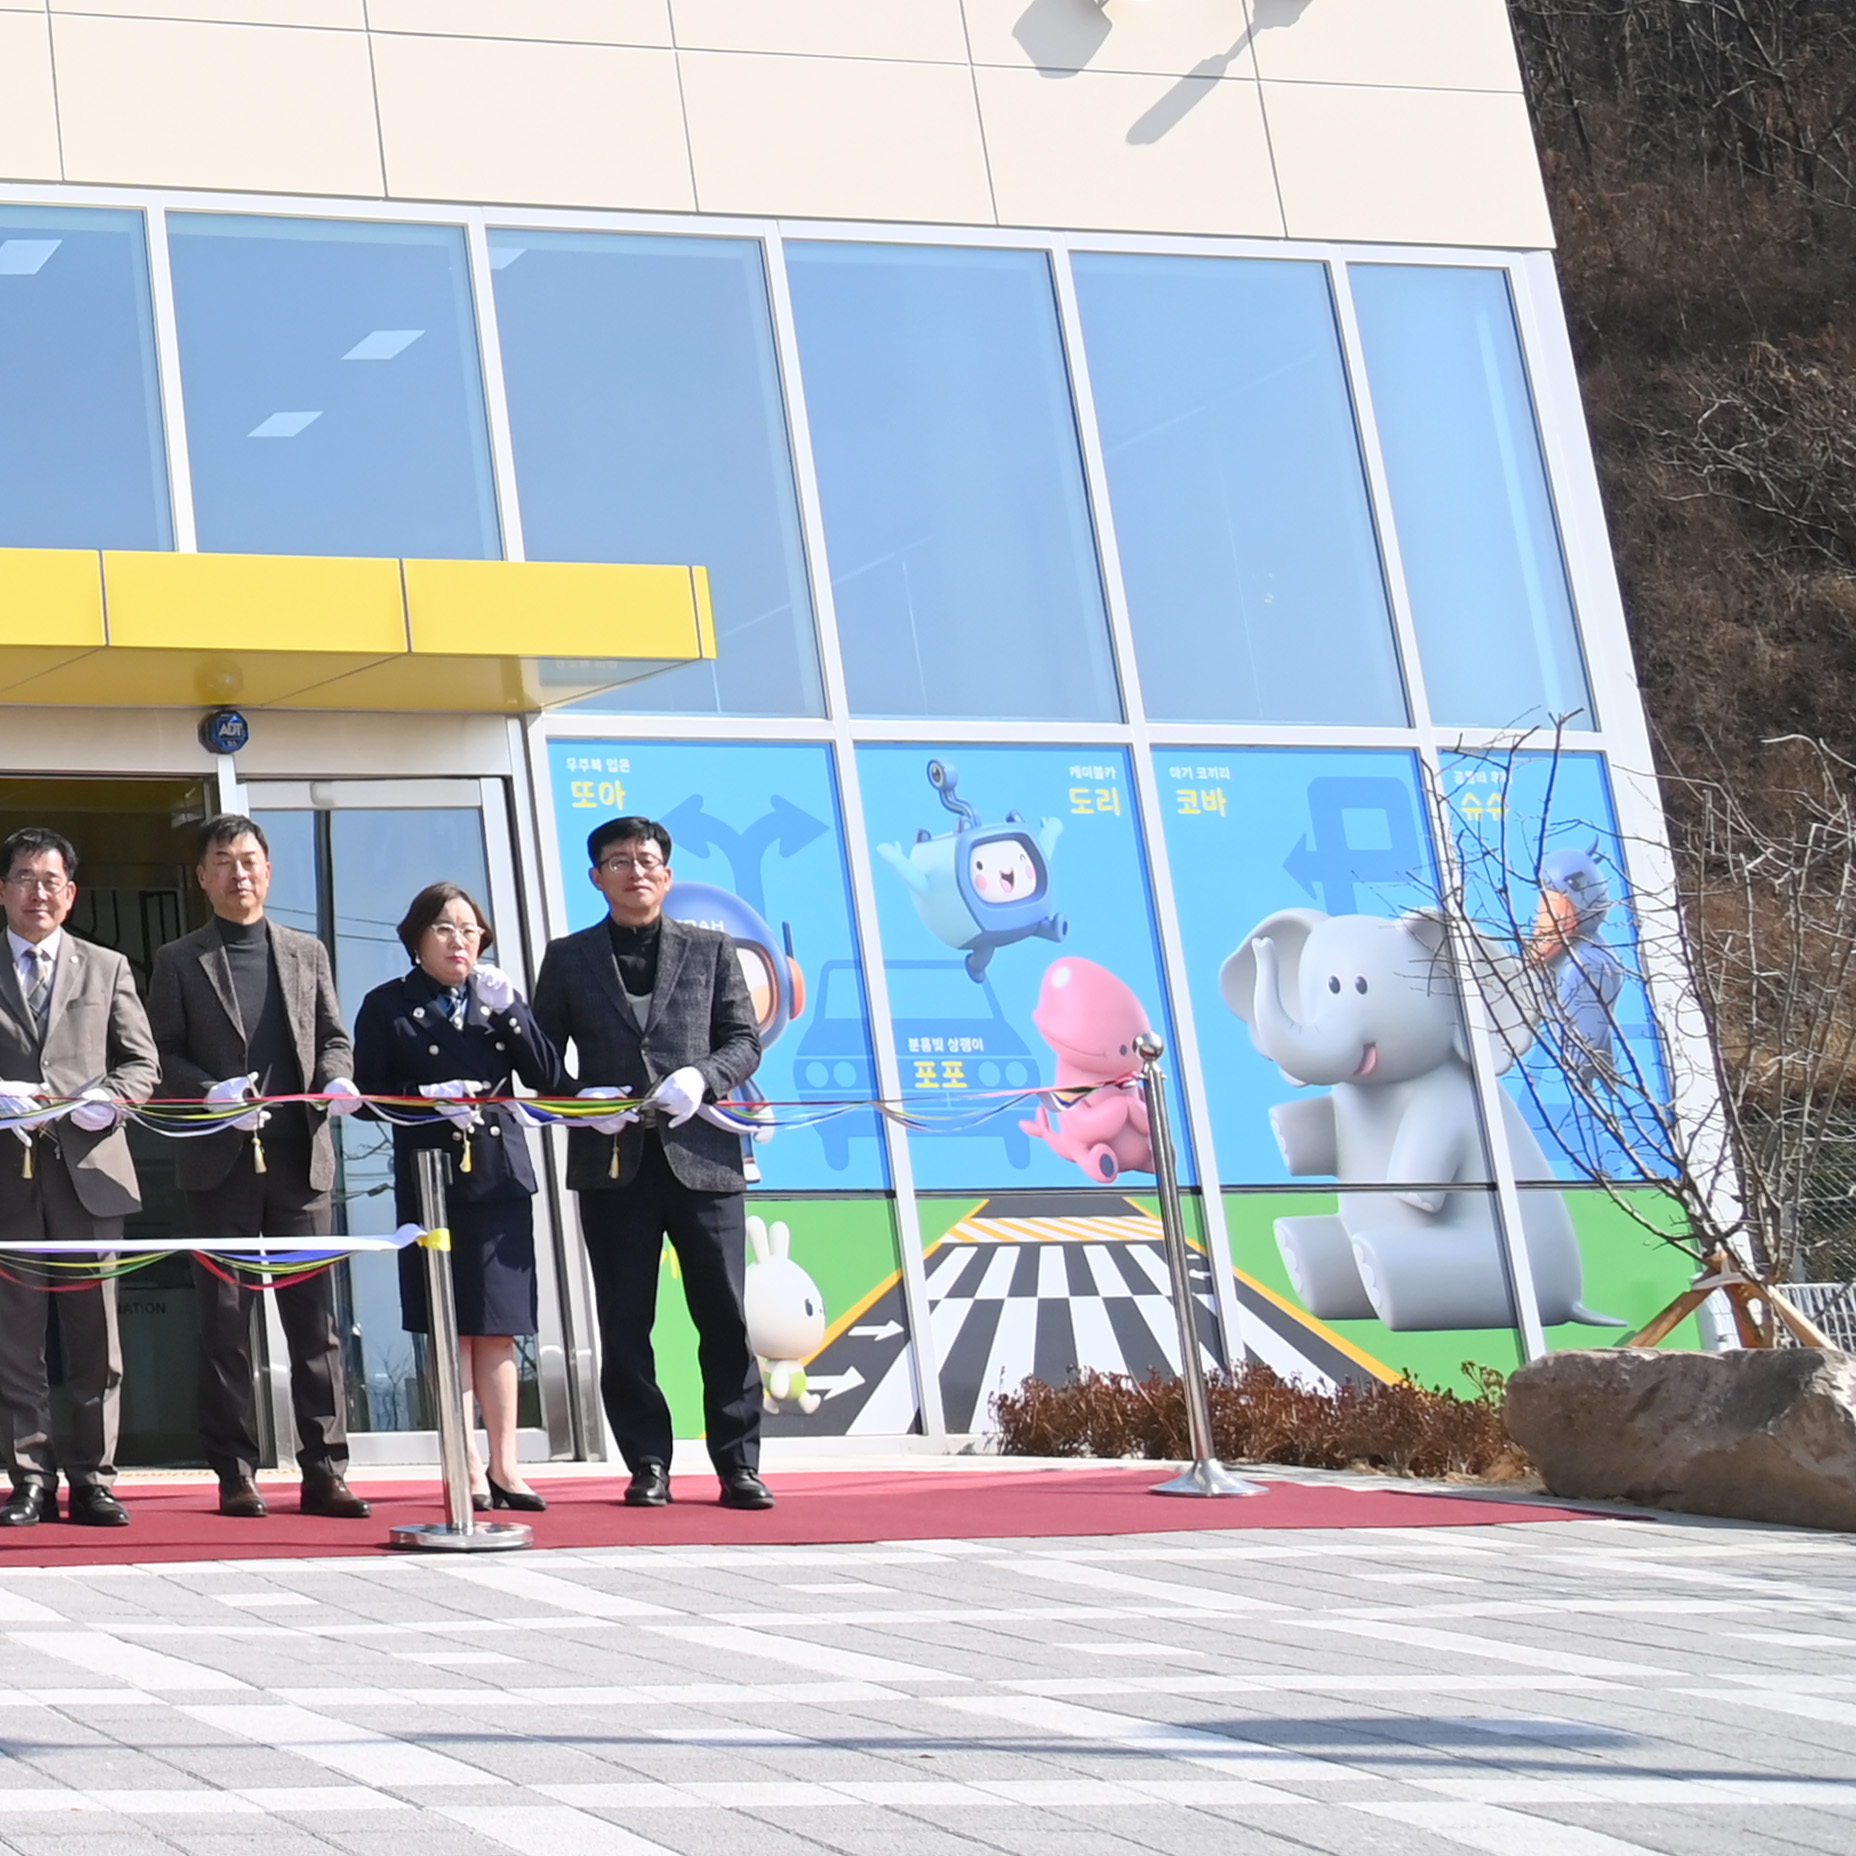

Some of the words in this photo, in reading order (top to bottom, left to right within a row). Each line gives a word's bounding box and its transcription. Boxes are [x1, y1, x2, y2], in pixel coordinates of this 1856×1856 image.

[218, 721, 243, 736] ADT
[1168, 766, 1194, 781] 아기
[1196, 766, 1231, 781] 코끼리
[570, 779, 627, 811] 또아
[1068, 787, 1122, 817] 도리
[1175, 787, 1228, 817] 코바
[913, 1060, 968, 1089] 포포
